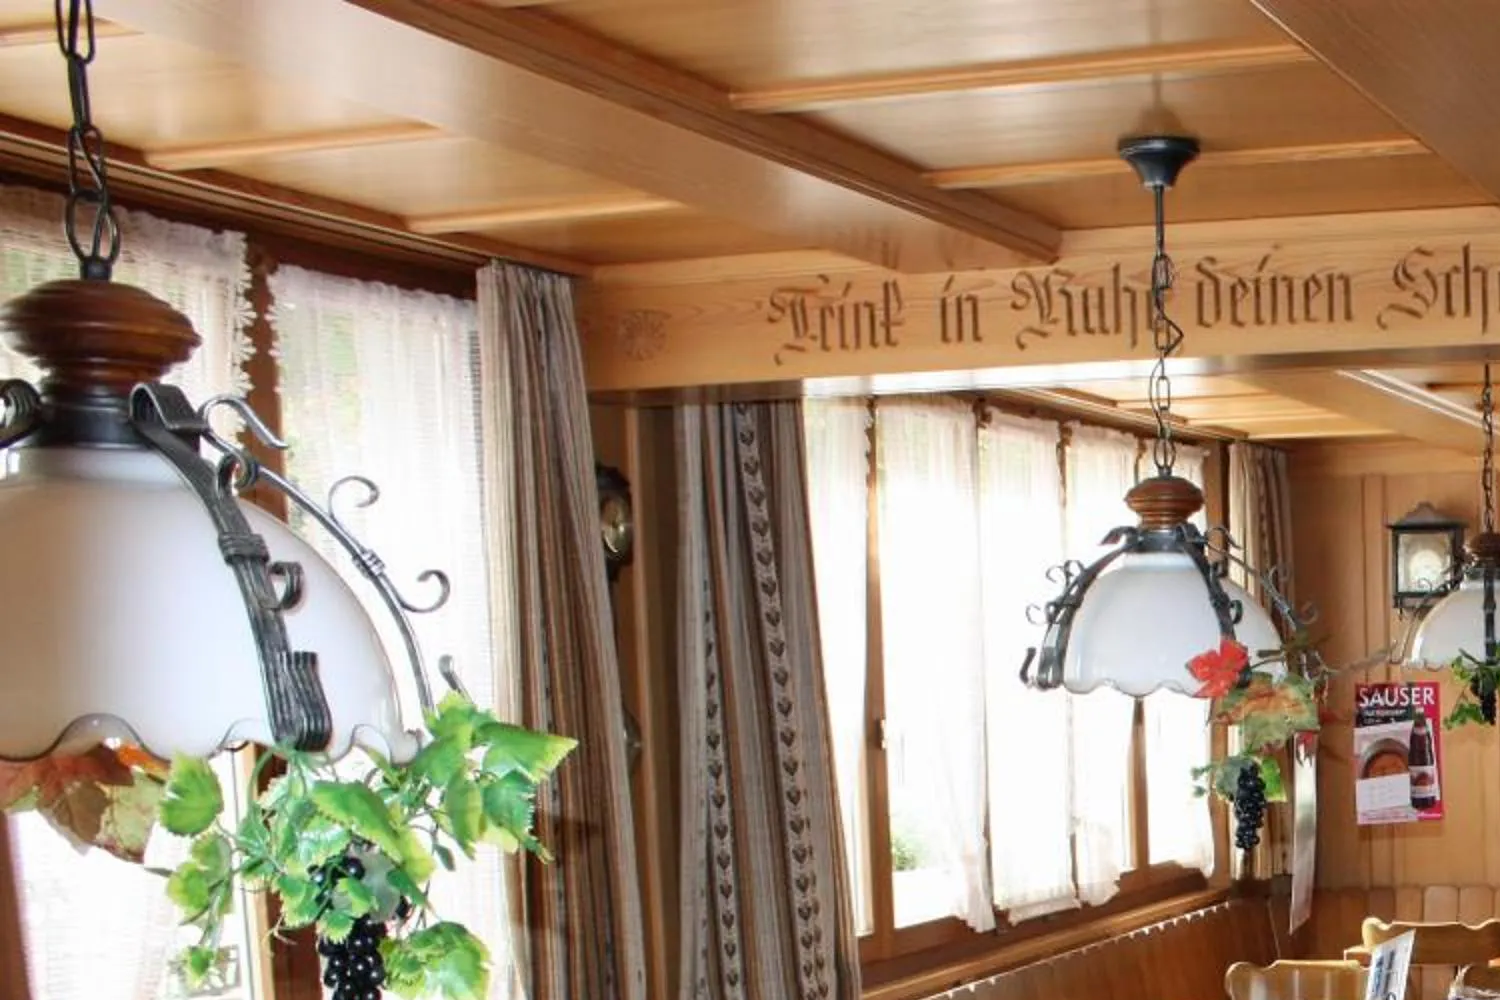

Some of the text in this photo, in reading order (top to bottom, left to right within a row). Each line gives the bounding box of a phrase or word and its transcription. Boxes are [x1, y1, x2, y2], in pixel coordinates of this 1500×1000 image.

[766, 275, 905, 366] Trink
[939, 274, 983, 344] in
[1195, 246, 1354, 328] deinen
[1359, 686, 1435, 707] SAUSER
